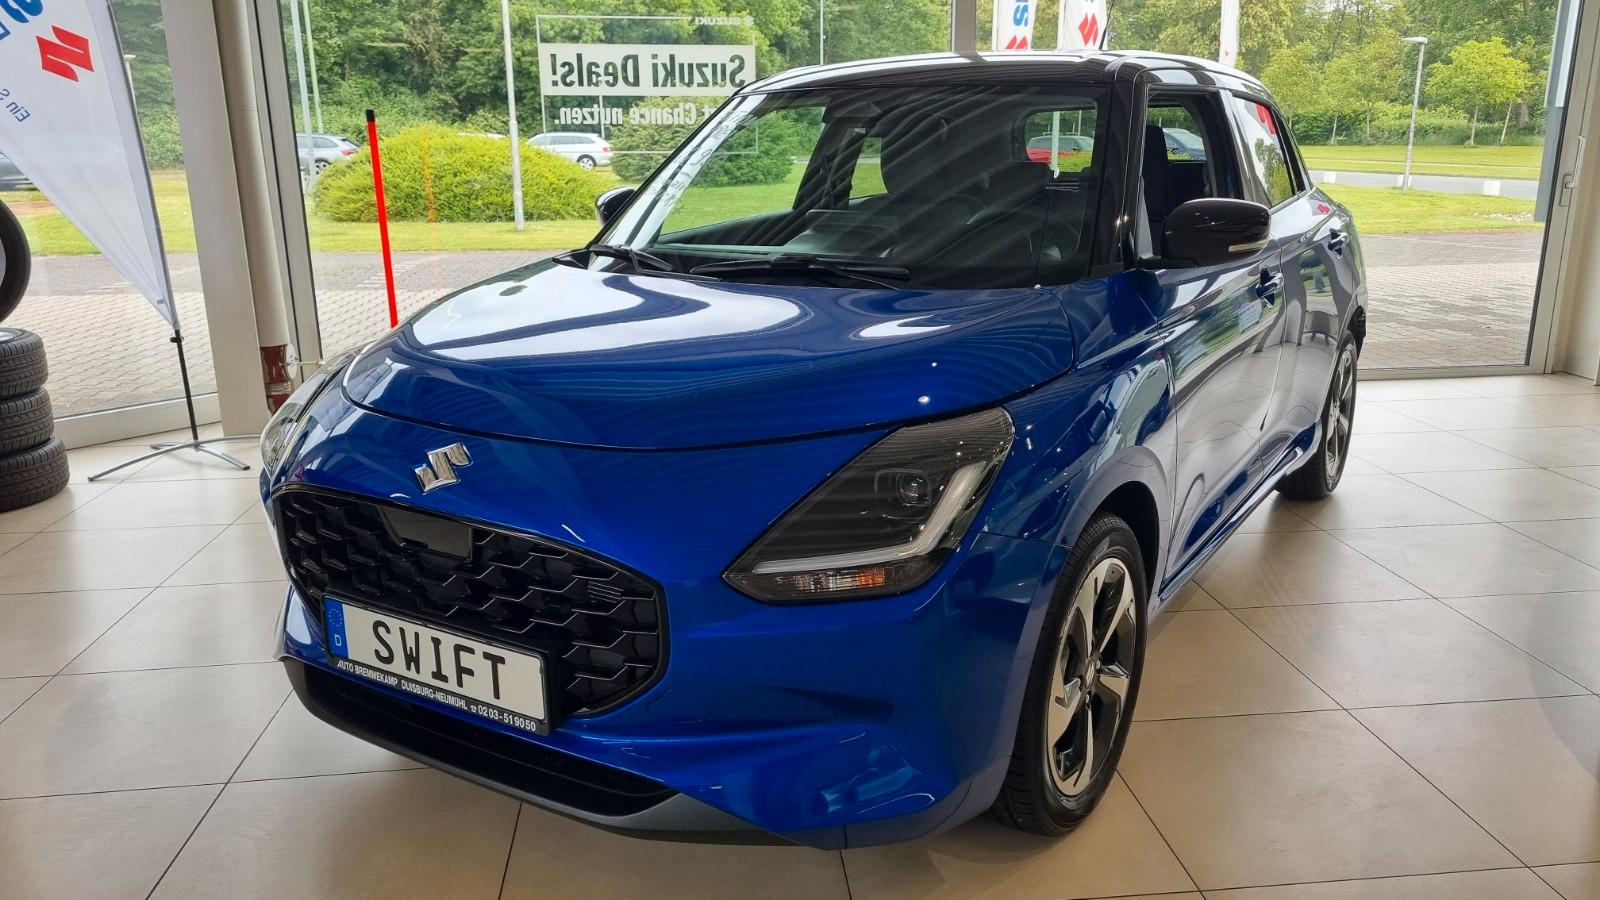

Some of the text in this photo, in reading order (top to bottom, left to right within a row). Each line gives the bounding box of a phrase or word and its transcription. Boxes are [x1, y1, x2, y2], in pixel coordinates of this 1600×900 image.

[334, 634, 342, 647] D
[337, 659, 354, 673] AUTO
[354, 664, 398, 687] BREMMEKAMP
[372, 619, 506, 700] SWIFT
